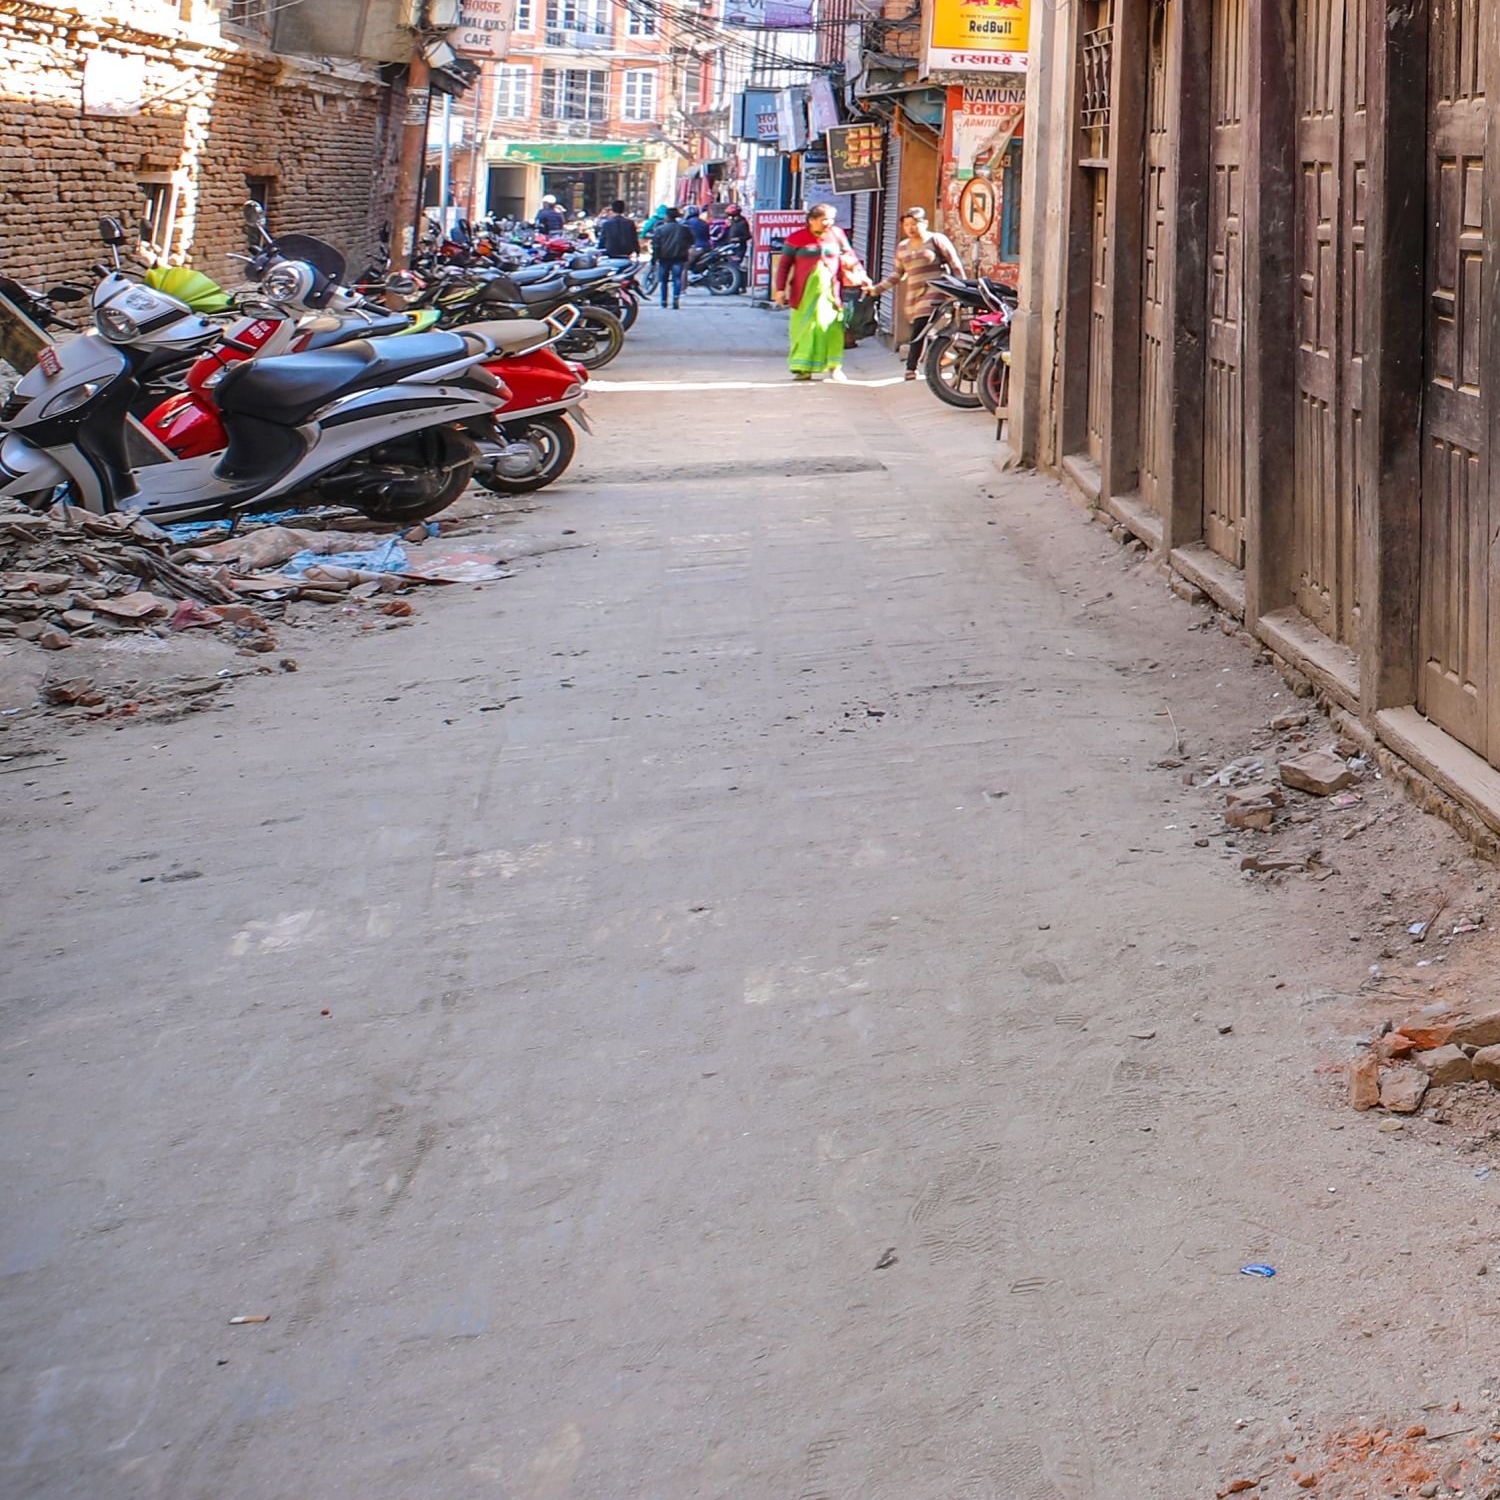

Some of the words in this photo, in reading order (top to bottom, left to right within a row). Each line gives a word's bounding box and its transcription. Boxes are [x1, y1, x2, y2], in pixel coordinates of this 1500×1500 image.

[465, 0, 502, 13] HOUSE
[464, 33, 492, 46] CAFE
[964, 88, 1026, 103] NAMUNA
[962, 103, 1019, 115] SCHOO
